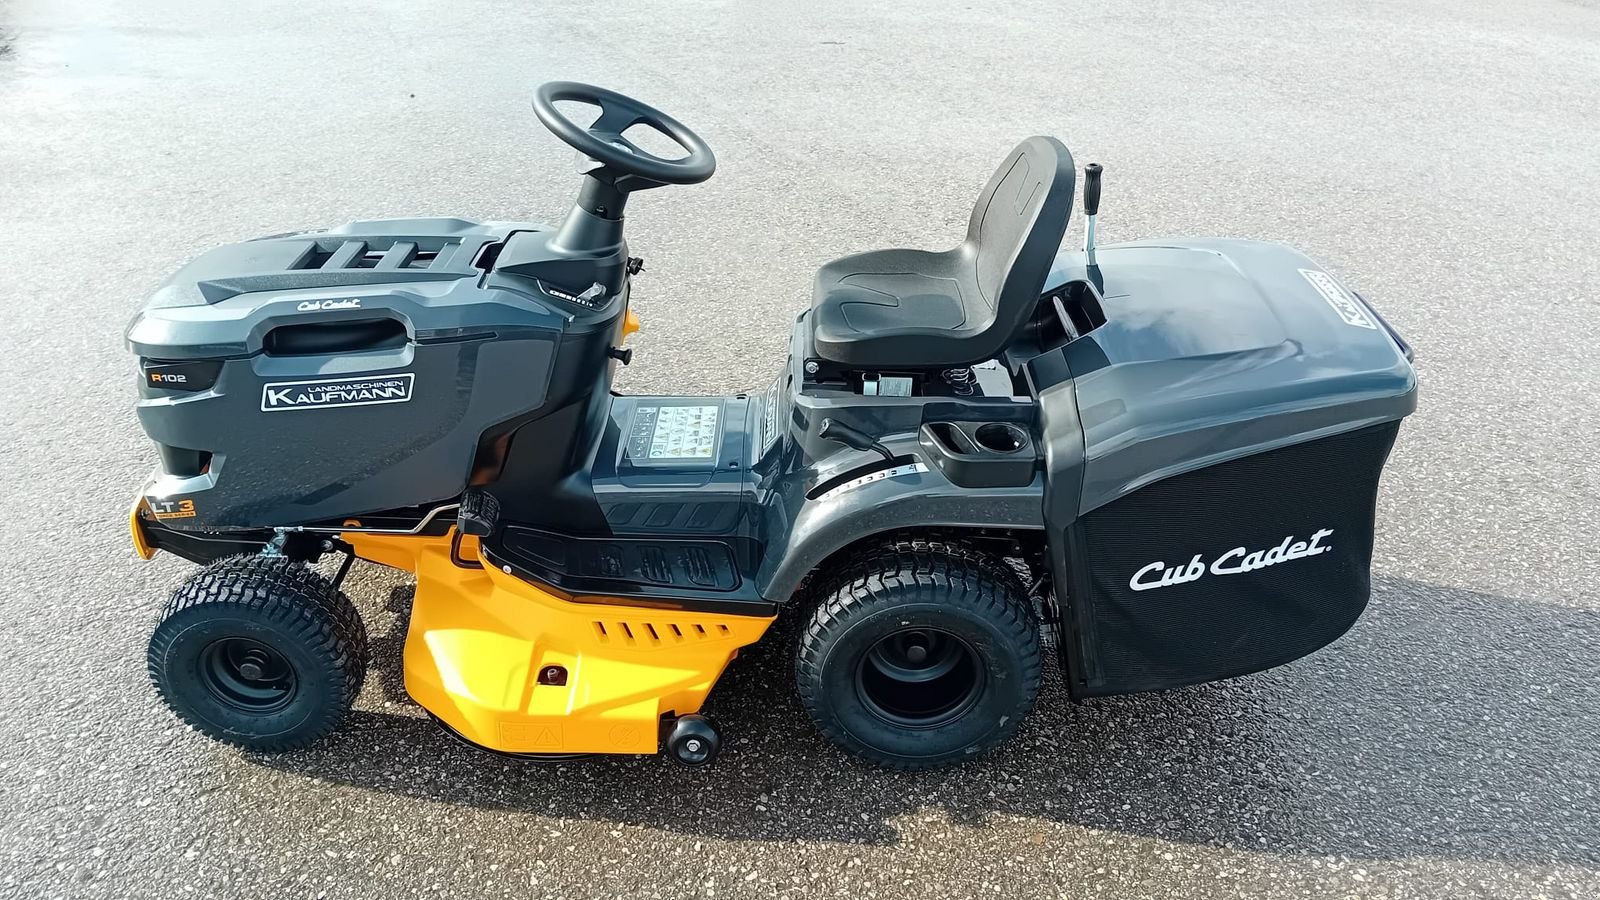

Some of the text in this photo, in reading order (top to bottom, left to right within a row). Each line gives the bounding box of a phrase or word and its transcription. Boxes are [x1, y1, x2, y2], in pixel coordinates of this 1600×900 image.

[151, 374, 188, 383] R102
[307, 380, 404, 393] LANDMASCHINEN
[267, 386, 406, 406] KAUFMANN
[152, 500, 194, 512] LT 3
[1129, 553, 1206, 591] Cub
